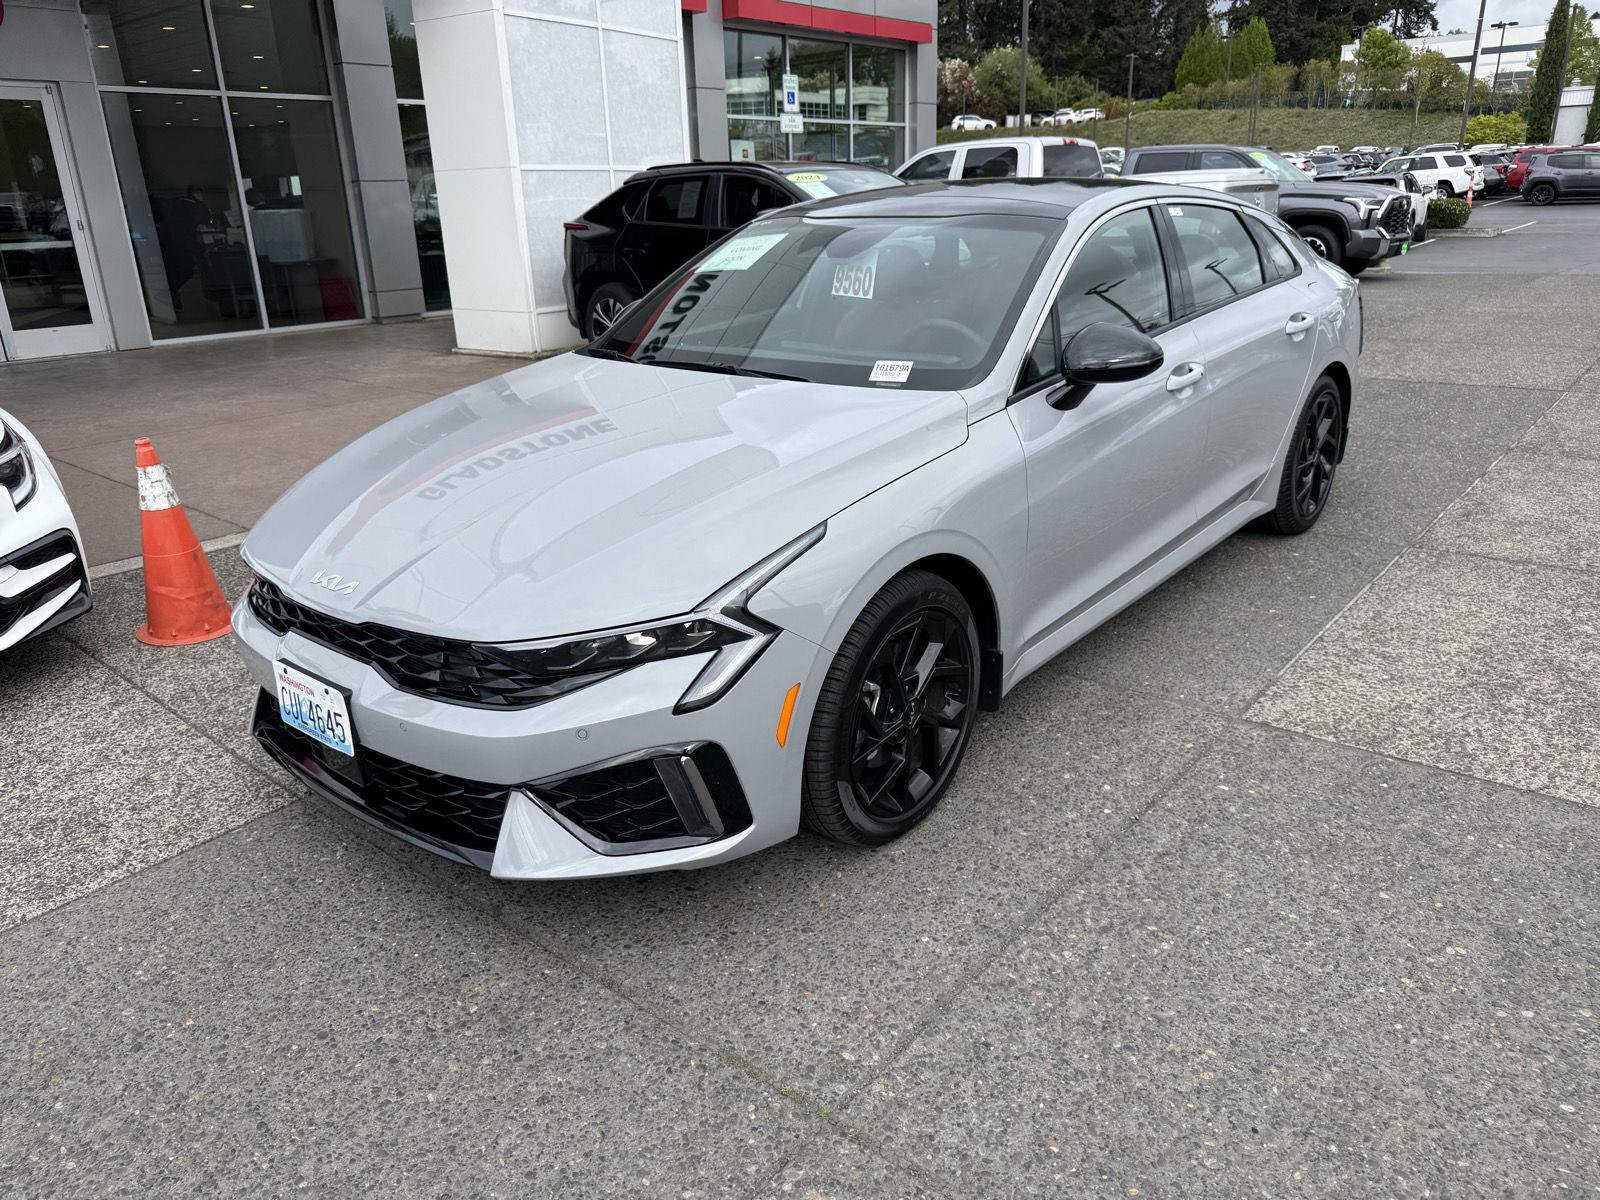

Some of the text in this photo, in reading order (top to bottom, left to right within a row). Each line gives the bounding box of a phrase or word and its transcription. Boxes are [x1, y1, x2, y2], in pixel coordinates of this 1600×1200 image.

[834, 265, 873, 297] 9560
[310, 568, 360, 595] KIA
[278, 673, 315, 697] WASHINGTON
[281, 686, 346, 744] CUL4645
